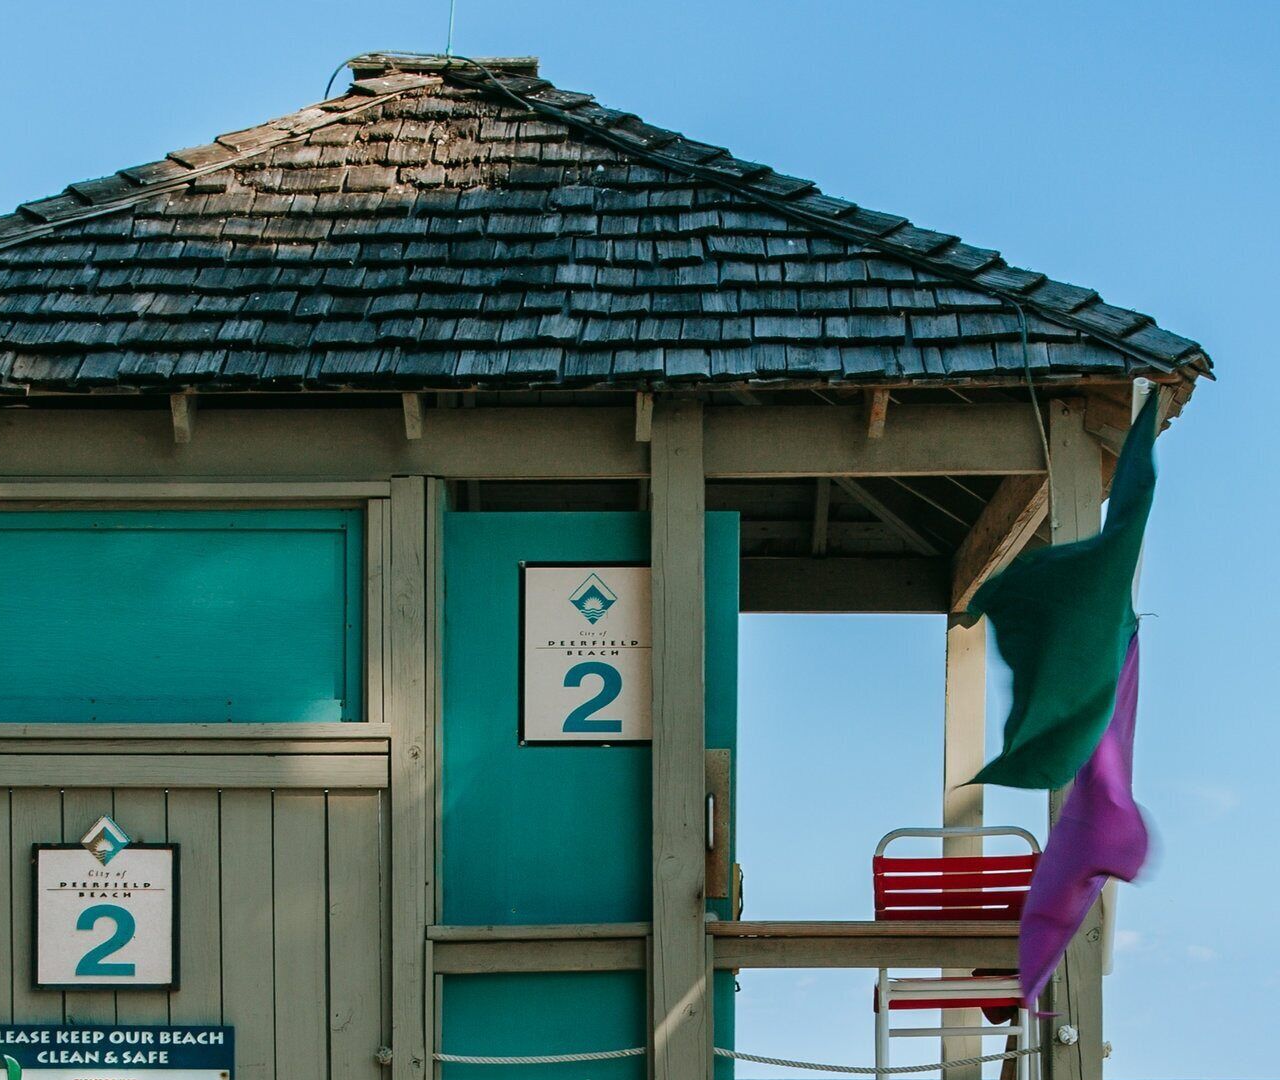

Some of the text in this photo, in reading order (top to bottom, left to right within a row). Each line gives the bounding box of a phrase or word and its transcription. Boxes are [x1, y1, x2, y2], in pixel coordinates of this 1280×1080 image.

[562, 661, 623, 733] 2
[88, 870, 127, 879] City of
[75, 904, 136, 976] 2
[56, 1031, 104, 1044] KEEP
[109, 1031, 154, 1045] OUR
[159, 1032, 224, 1045] BEACH
[37, 1051, 169, 1064] CLEAN & SAFE
